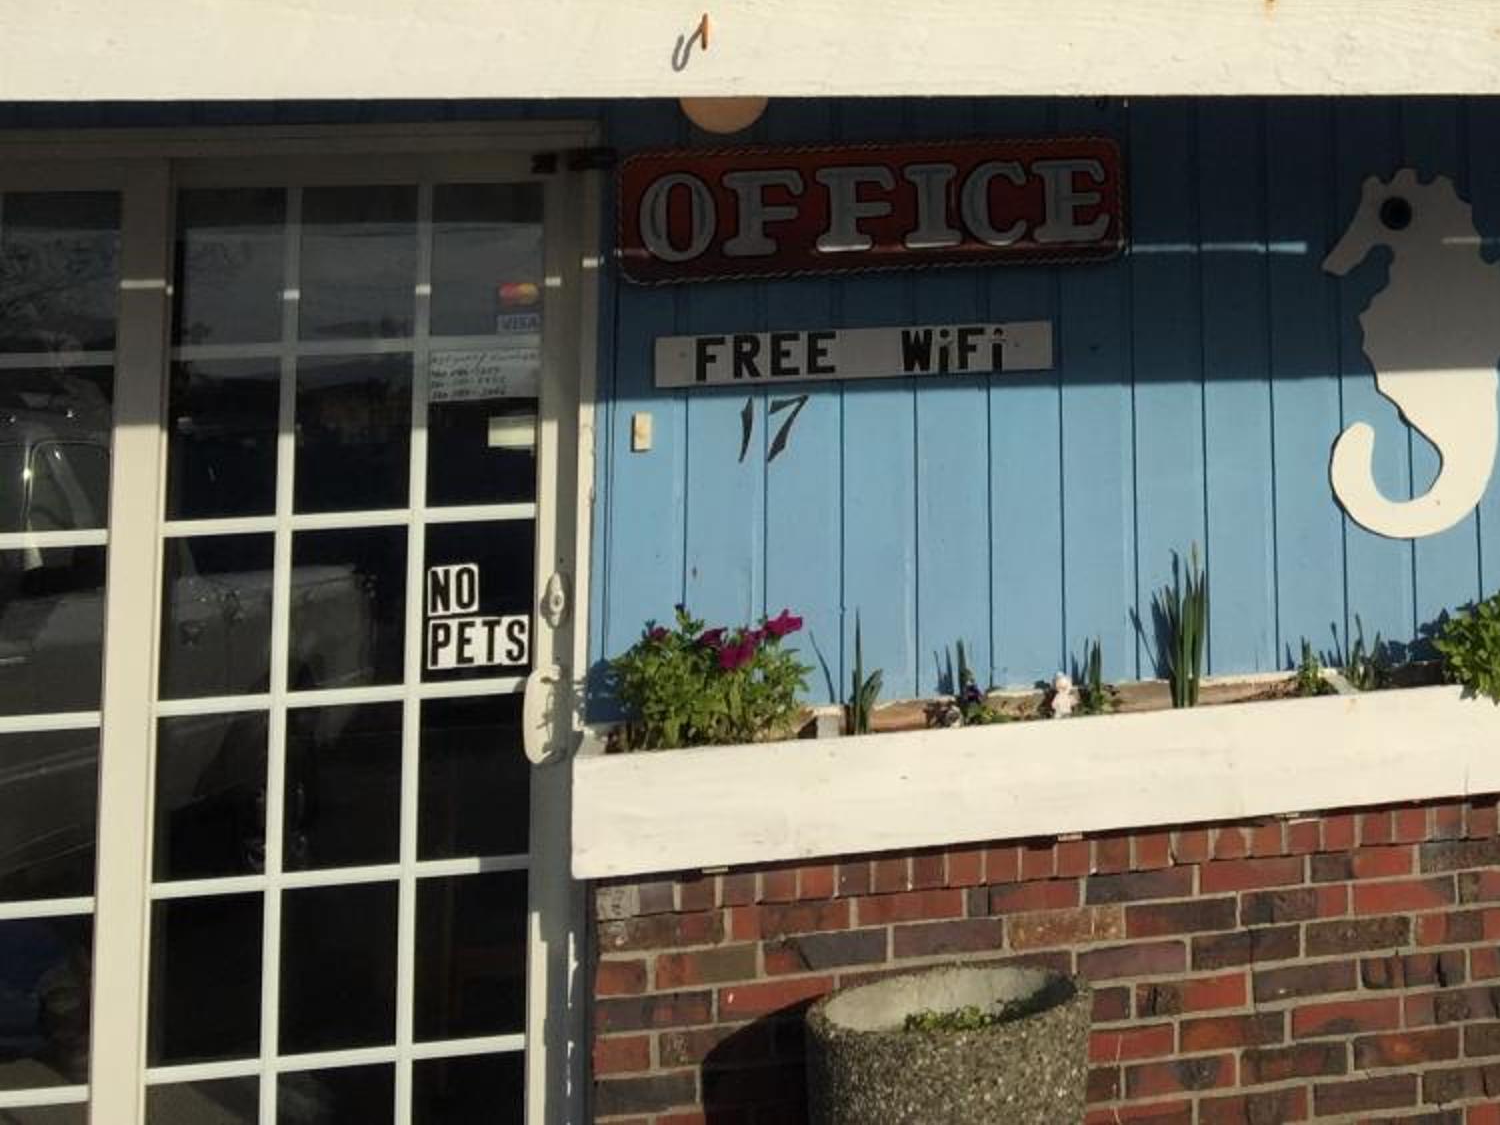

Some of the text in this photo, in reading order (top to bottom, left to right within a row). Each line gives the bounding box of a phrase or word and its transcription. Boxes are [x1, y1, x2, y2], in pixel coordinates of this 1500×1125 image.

[638, 157, 1111, 262] OFFICE
[695, 328, 1004, 381] FREE WiFi
[738, 394, 808, 463] 17
[430, 567, 475, 613] NO
[430, 620, 526, 667] PETS
